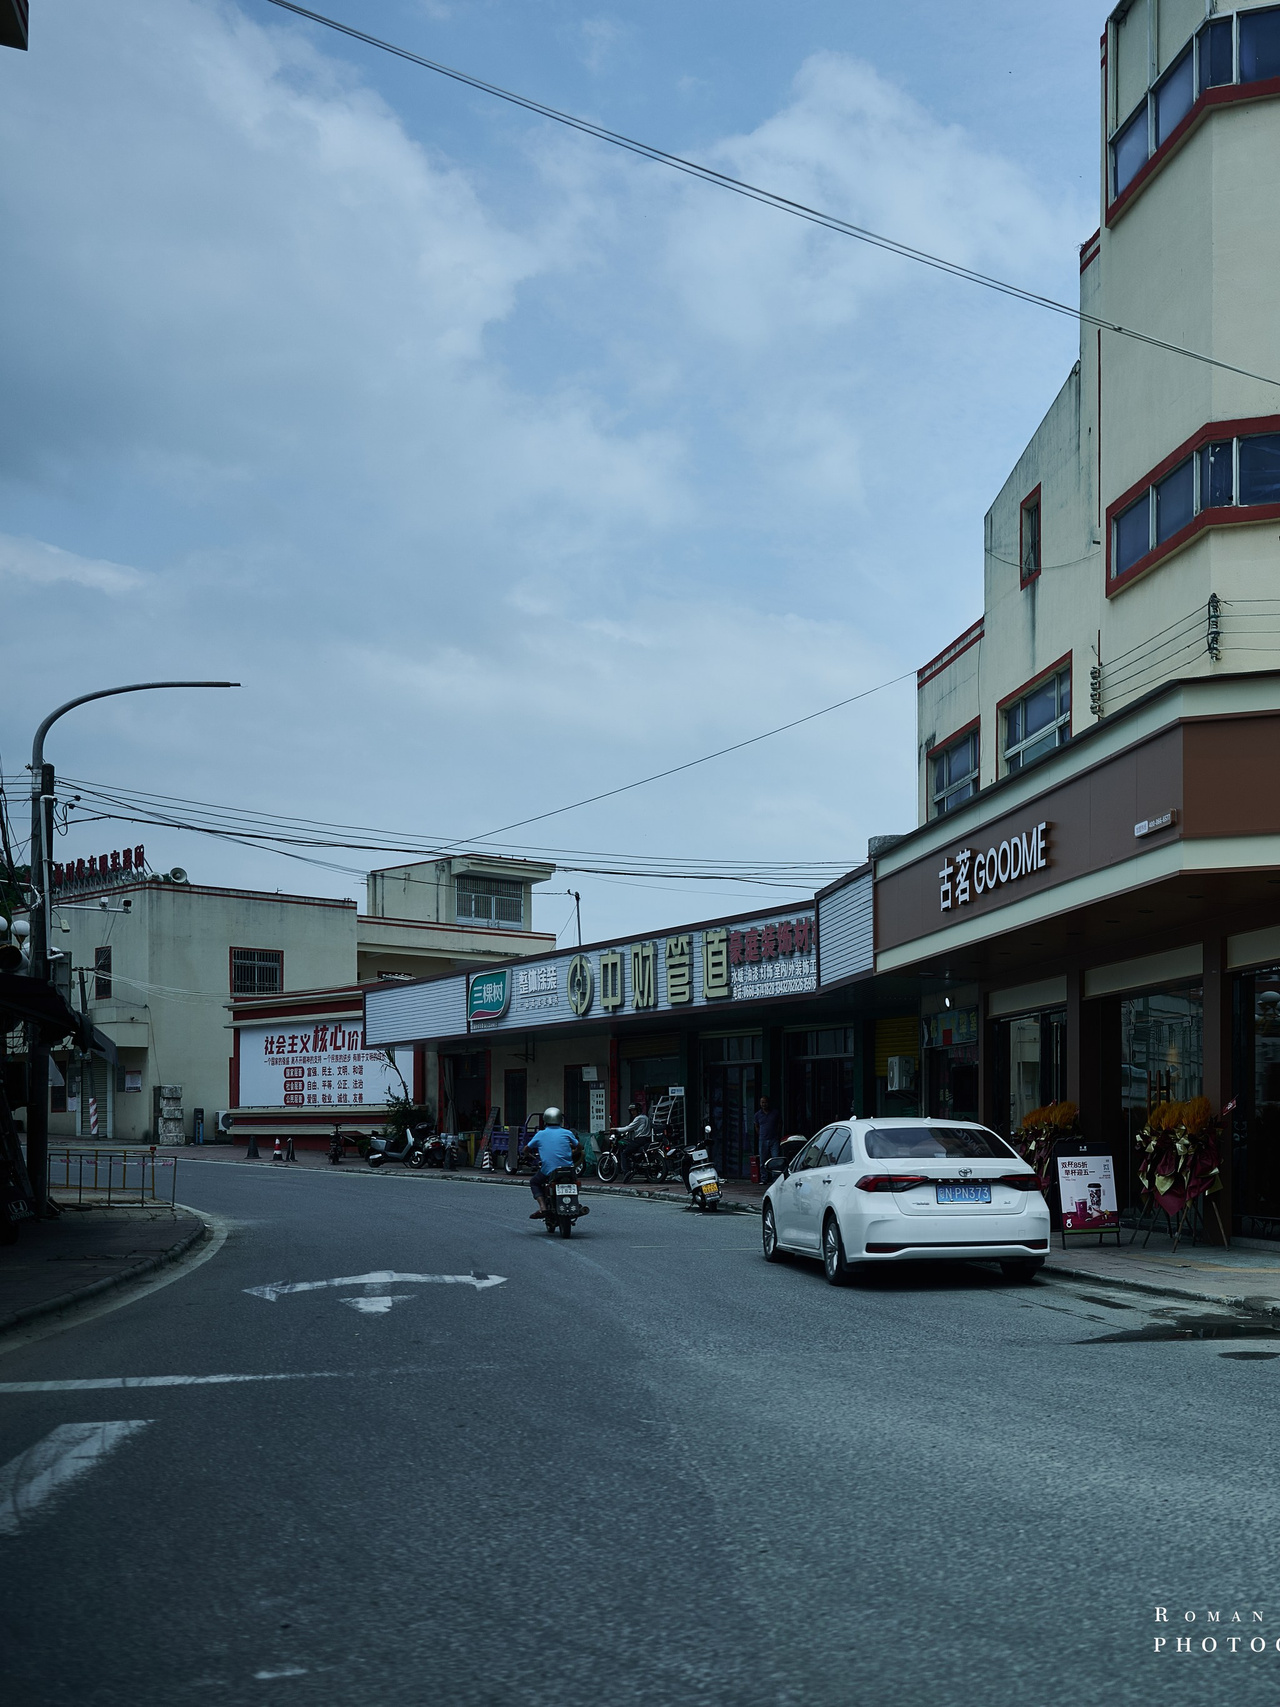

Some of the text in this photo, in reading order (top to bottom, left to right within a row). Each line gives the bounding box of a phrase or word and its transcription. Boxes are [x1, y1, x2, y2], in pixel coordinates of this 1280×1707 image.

[938, 821, 1047, 912] 古茗 GOODME
[473, 982, 503, 1004] 三棵树
[600, 927, 730, 1012] 中财管道
[264, 1024, 364, 1055] 社会主义核心价
